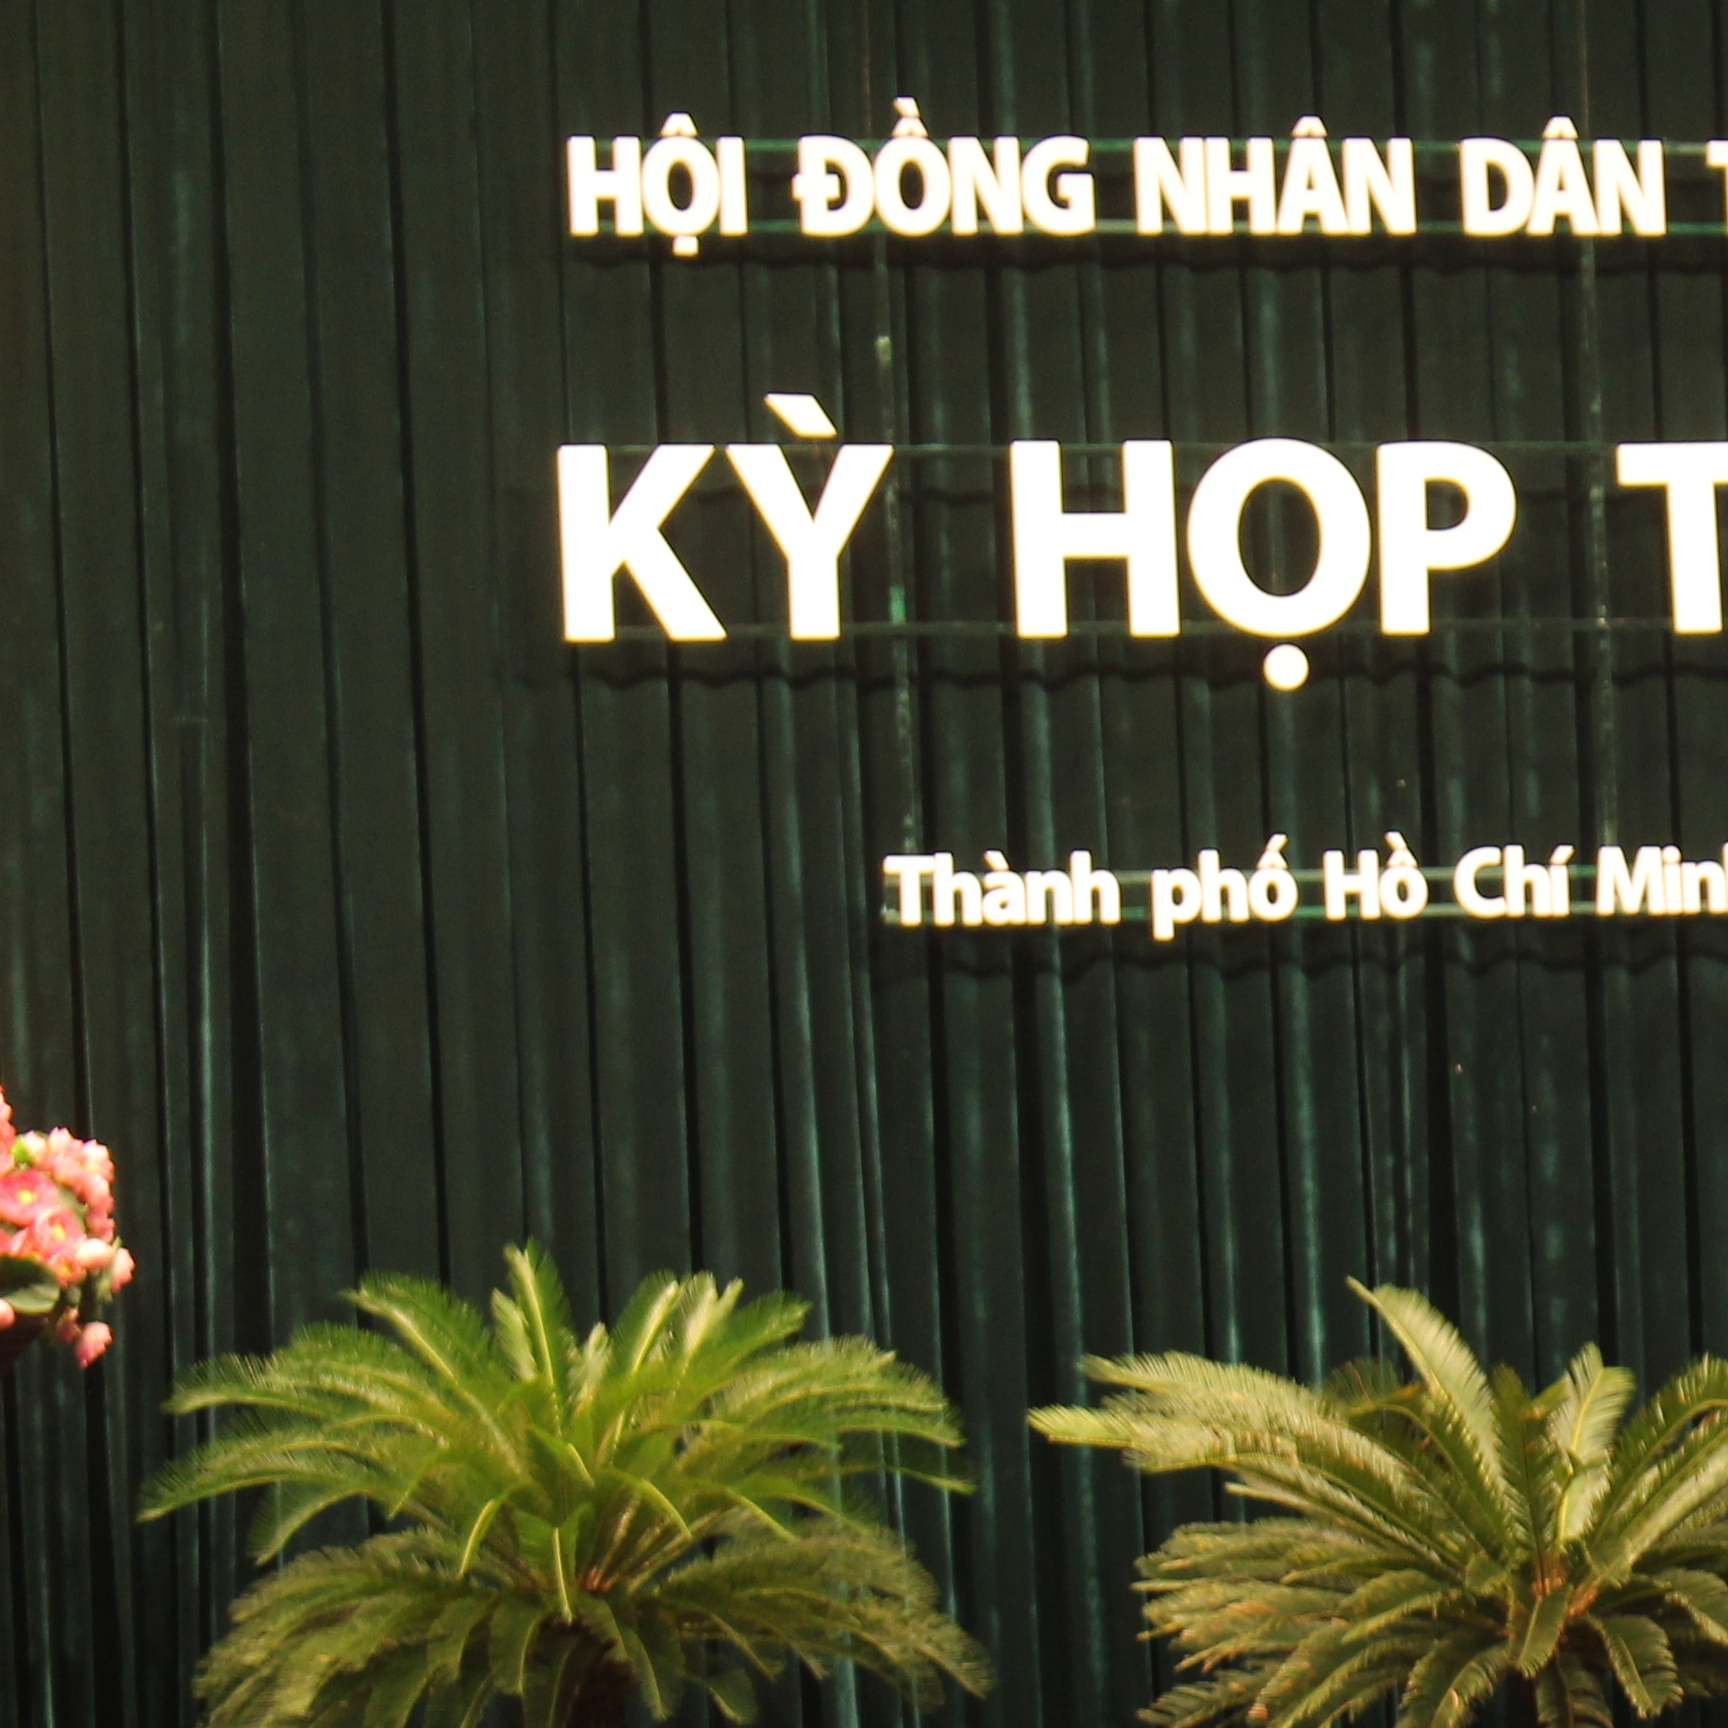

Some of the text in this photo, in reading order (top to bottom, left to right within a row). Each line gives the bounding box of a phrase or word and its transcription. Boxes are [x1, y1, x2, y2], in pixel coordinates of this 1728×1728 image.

[566, 112, 748, 256] HỘI
[791, 96, 1096, 235] ĐỒNG
[1133, 115, 1417, 234] NHÂN
[1459, 115, 1667, 235] DÂN
[556, 392, 894, 641] KỲ
[1009, 437, 1516, 689] HỌP
[882, 849, 1121, 925] Thành
[1149, 832, 1299, 940] phố
[1322, 830, 1429, 919] Hồ
[1452, 843, 1574, 917] Chí
